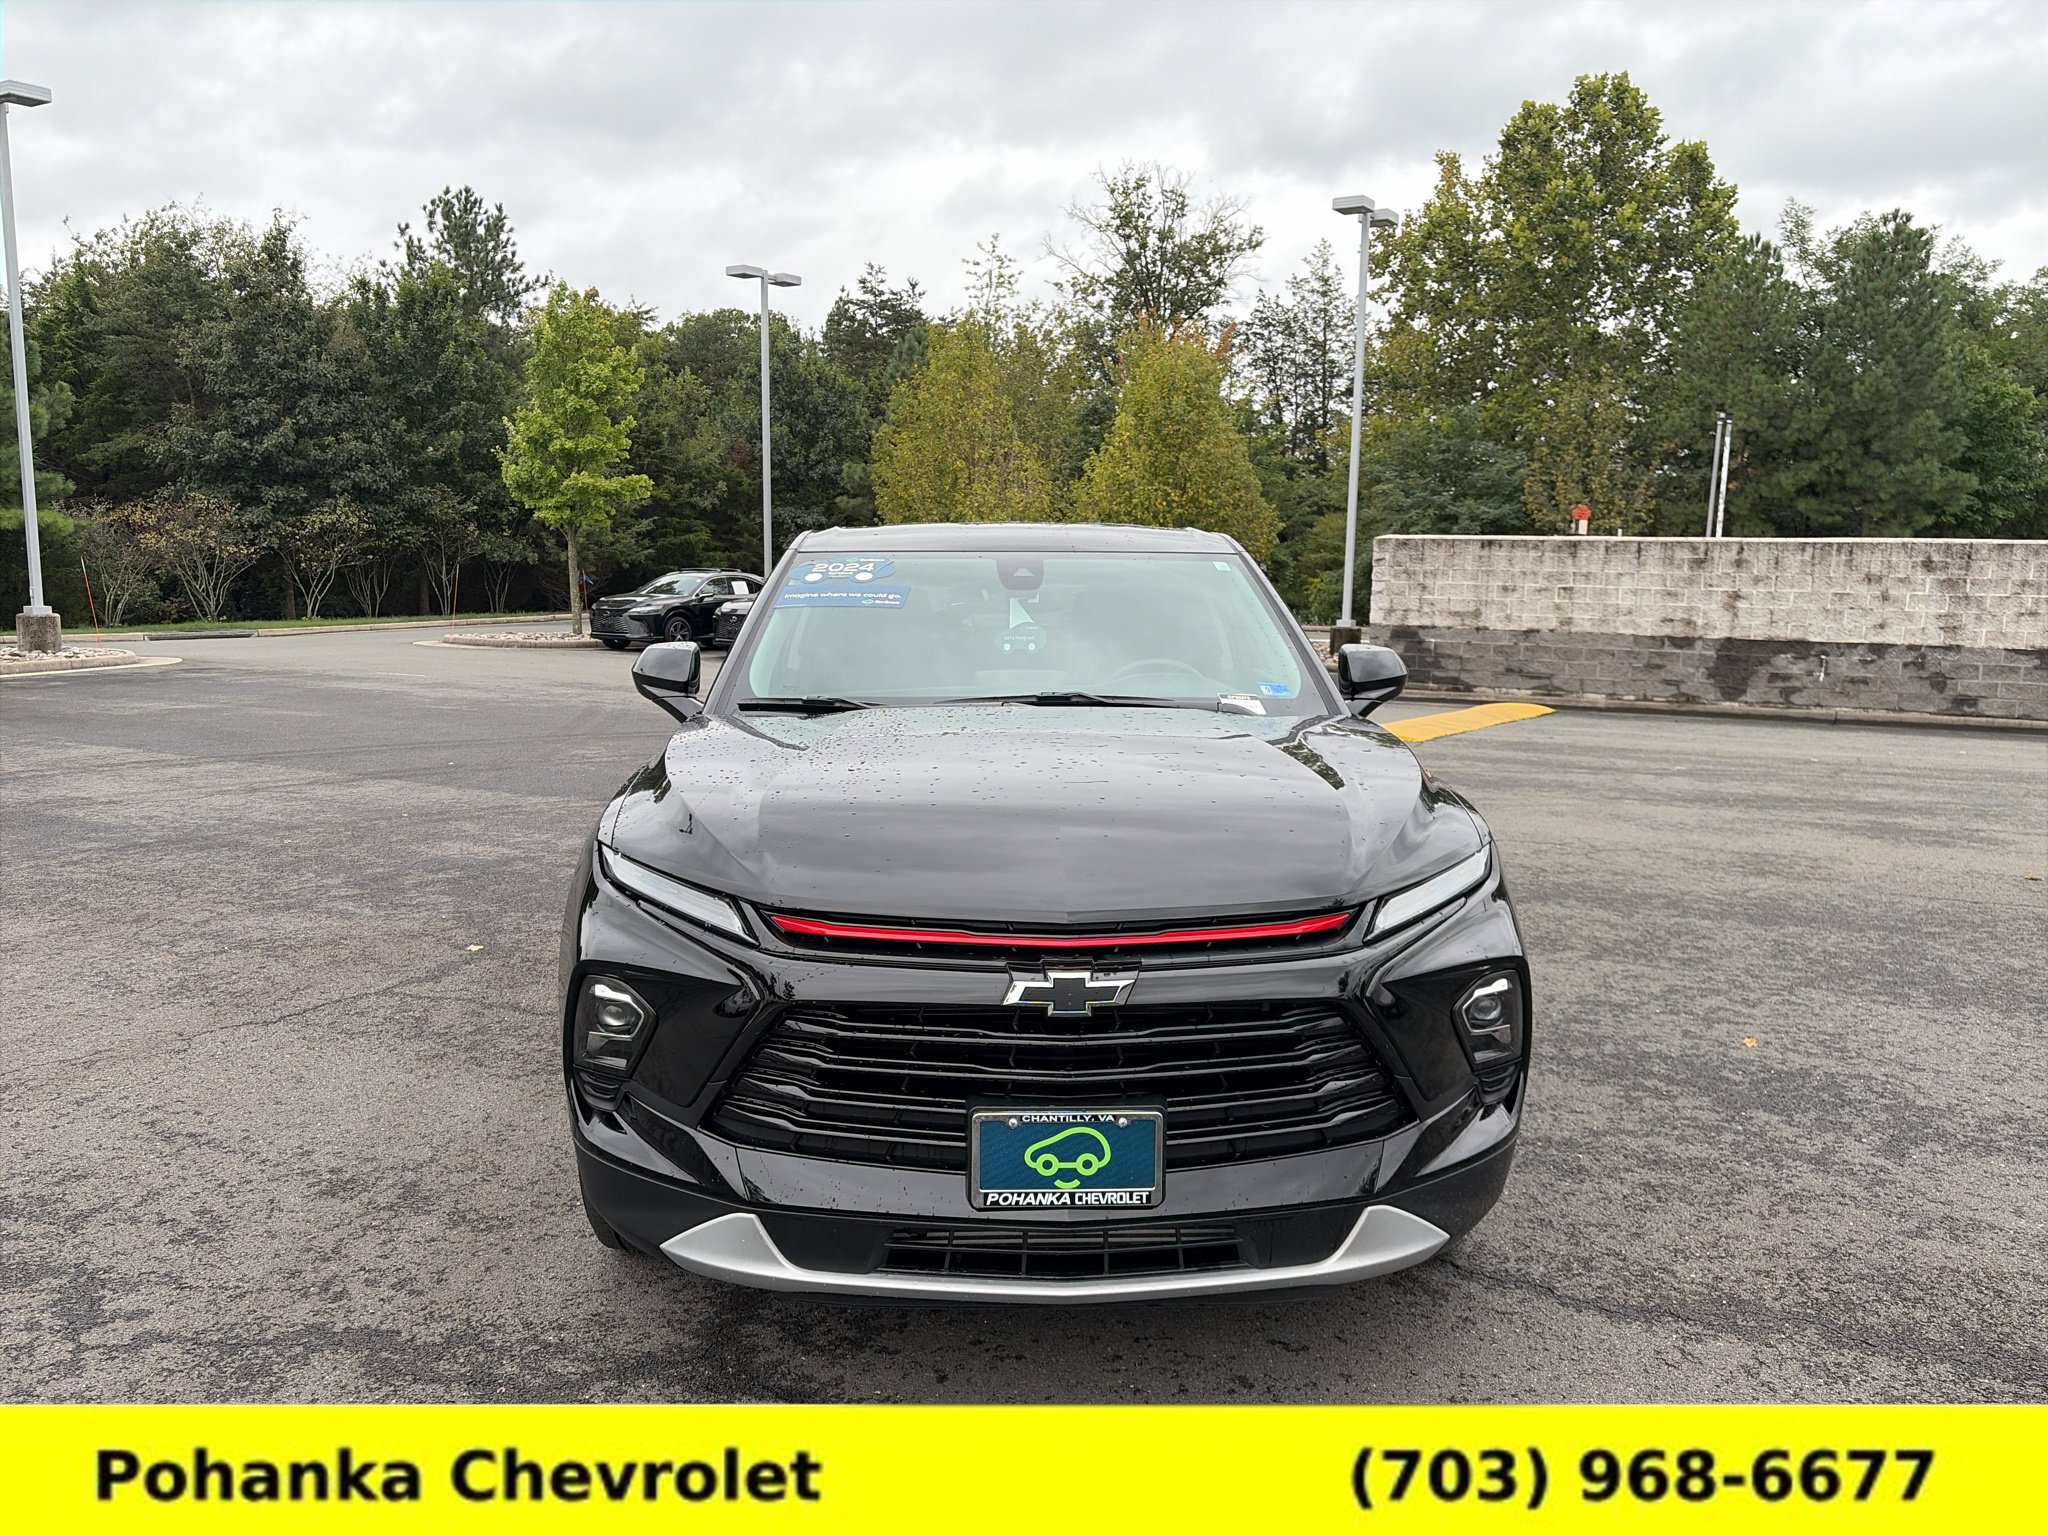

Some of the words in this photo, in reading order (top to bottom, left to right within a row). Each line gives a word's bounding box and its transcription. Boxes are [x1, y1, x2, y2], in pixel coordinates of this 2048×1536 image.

[812, 562, 874, 572] 2024
[1097, 1114, 1116, 1122] VA
[986, 1192, 1071, 1206] POHANKA
[1074, 1191, 1149, 1206] CHEVROLET
